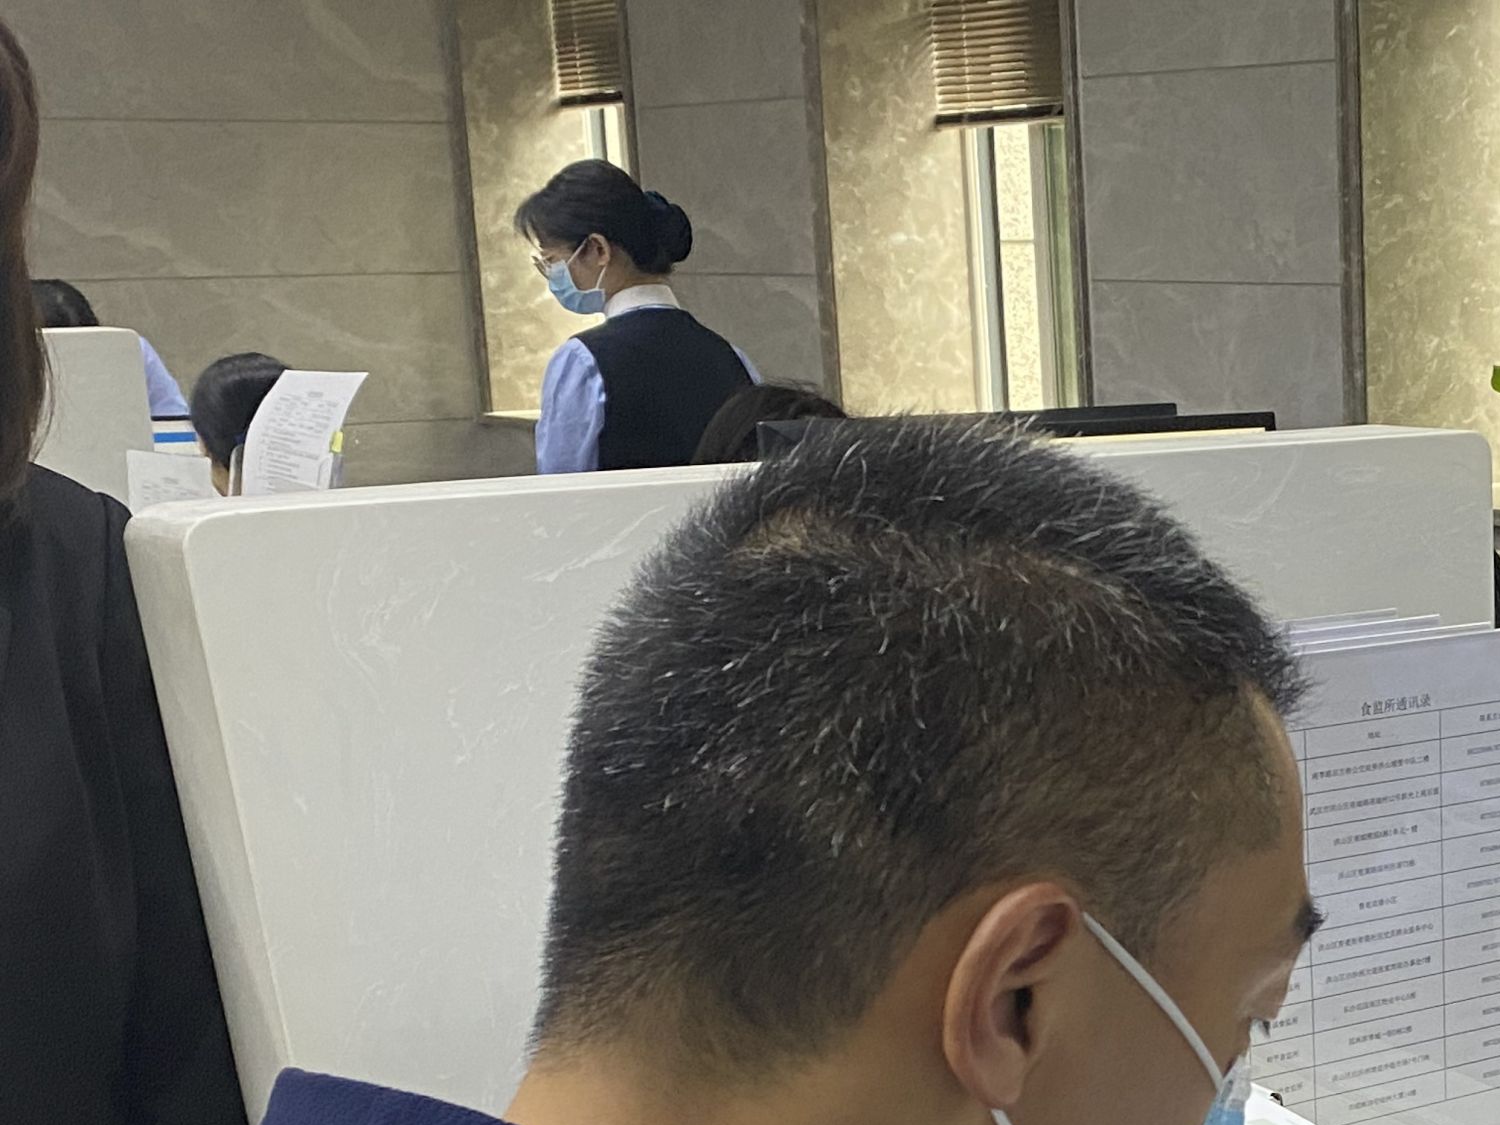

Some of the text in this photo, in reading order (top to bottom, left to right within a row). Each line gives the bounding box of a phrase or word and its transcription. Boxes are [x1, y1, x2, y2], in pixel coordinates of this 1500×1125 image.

[1360, 693, 1432, 717] 食监所通讯录
